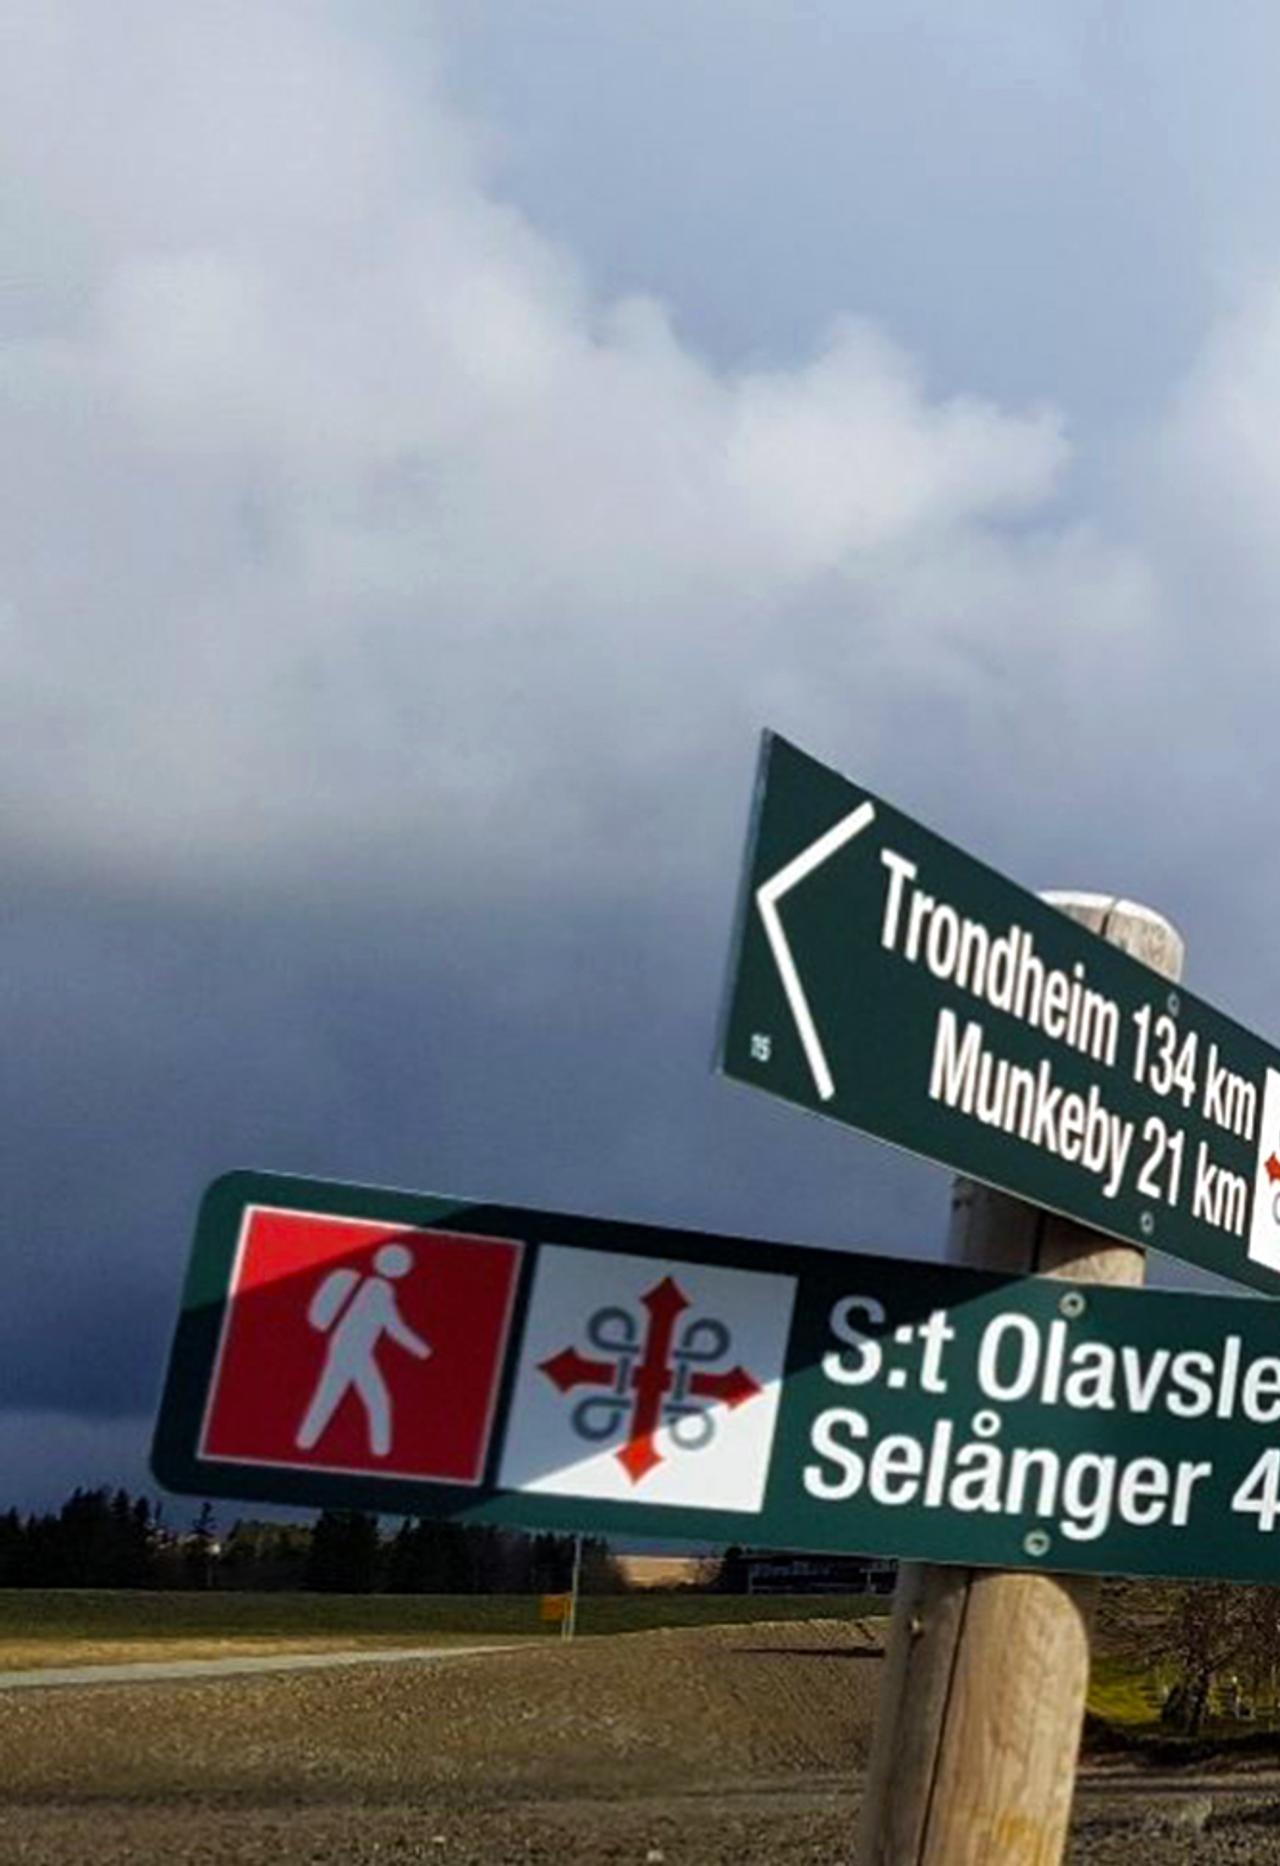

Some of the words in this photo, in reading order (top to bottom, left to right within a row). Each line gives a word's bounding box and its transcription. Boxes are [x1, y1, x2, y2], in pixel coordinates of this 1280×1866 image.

[880, 848, 1120, 1067] Trondheim
[1133, 1003, 1198, 1108] 134
[1203, 1043, 1257, 1142] km
[928, 1007, 1135, 1198] Munkeby
[1136, 1115, 1184, 1207] 21
[1192, 1140, 1248, 1236] km
[821, 1295, 955, 1394] S:t
[803, 1407, 1213, 1542] Selånger
